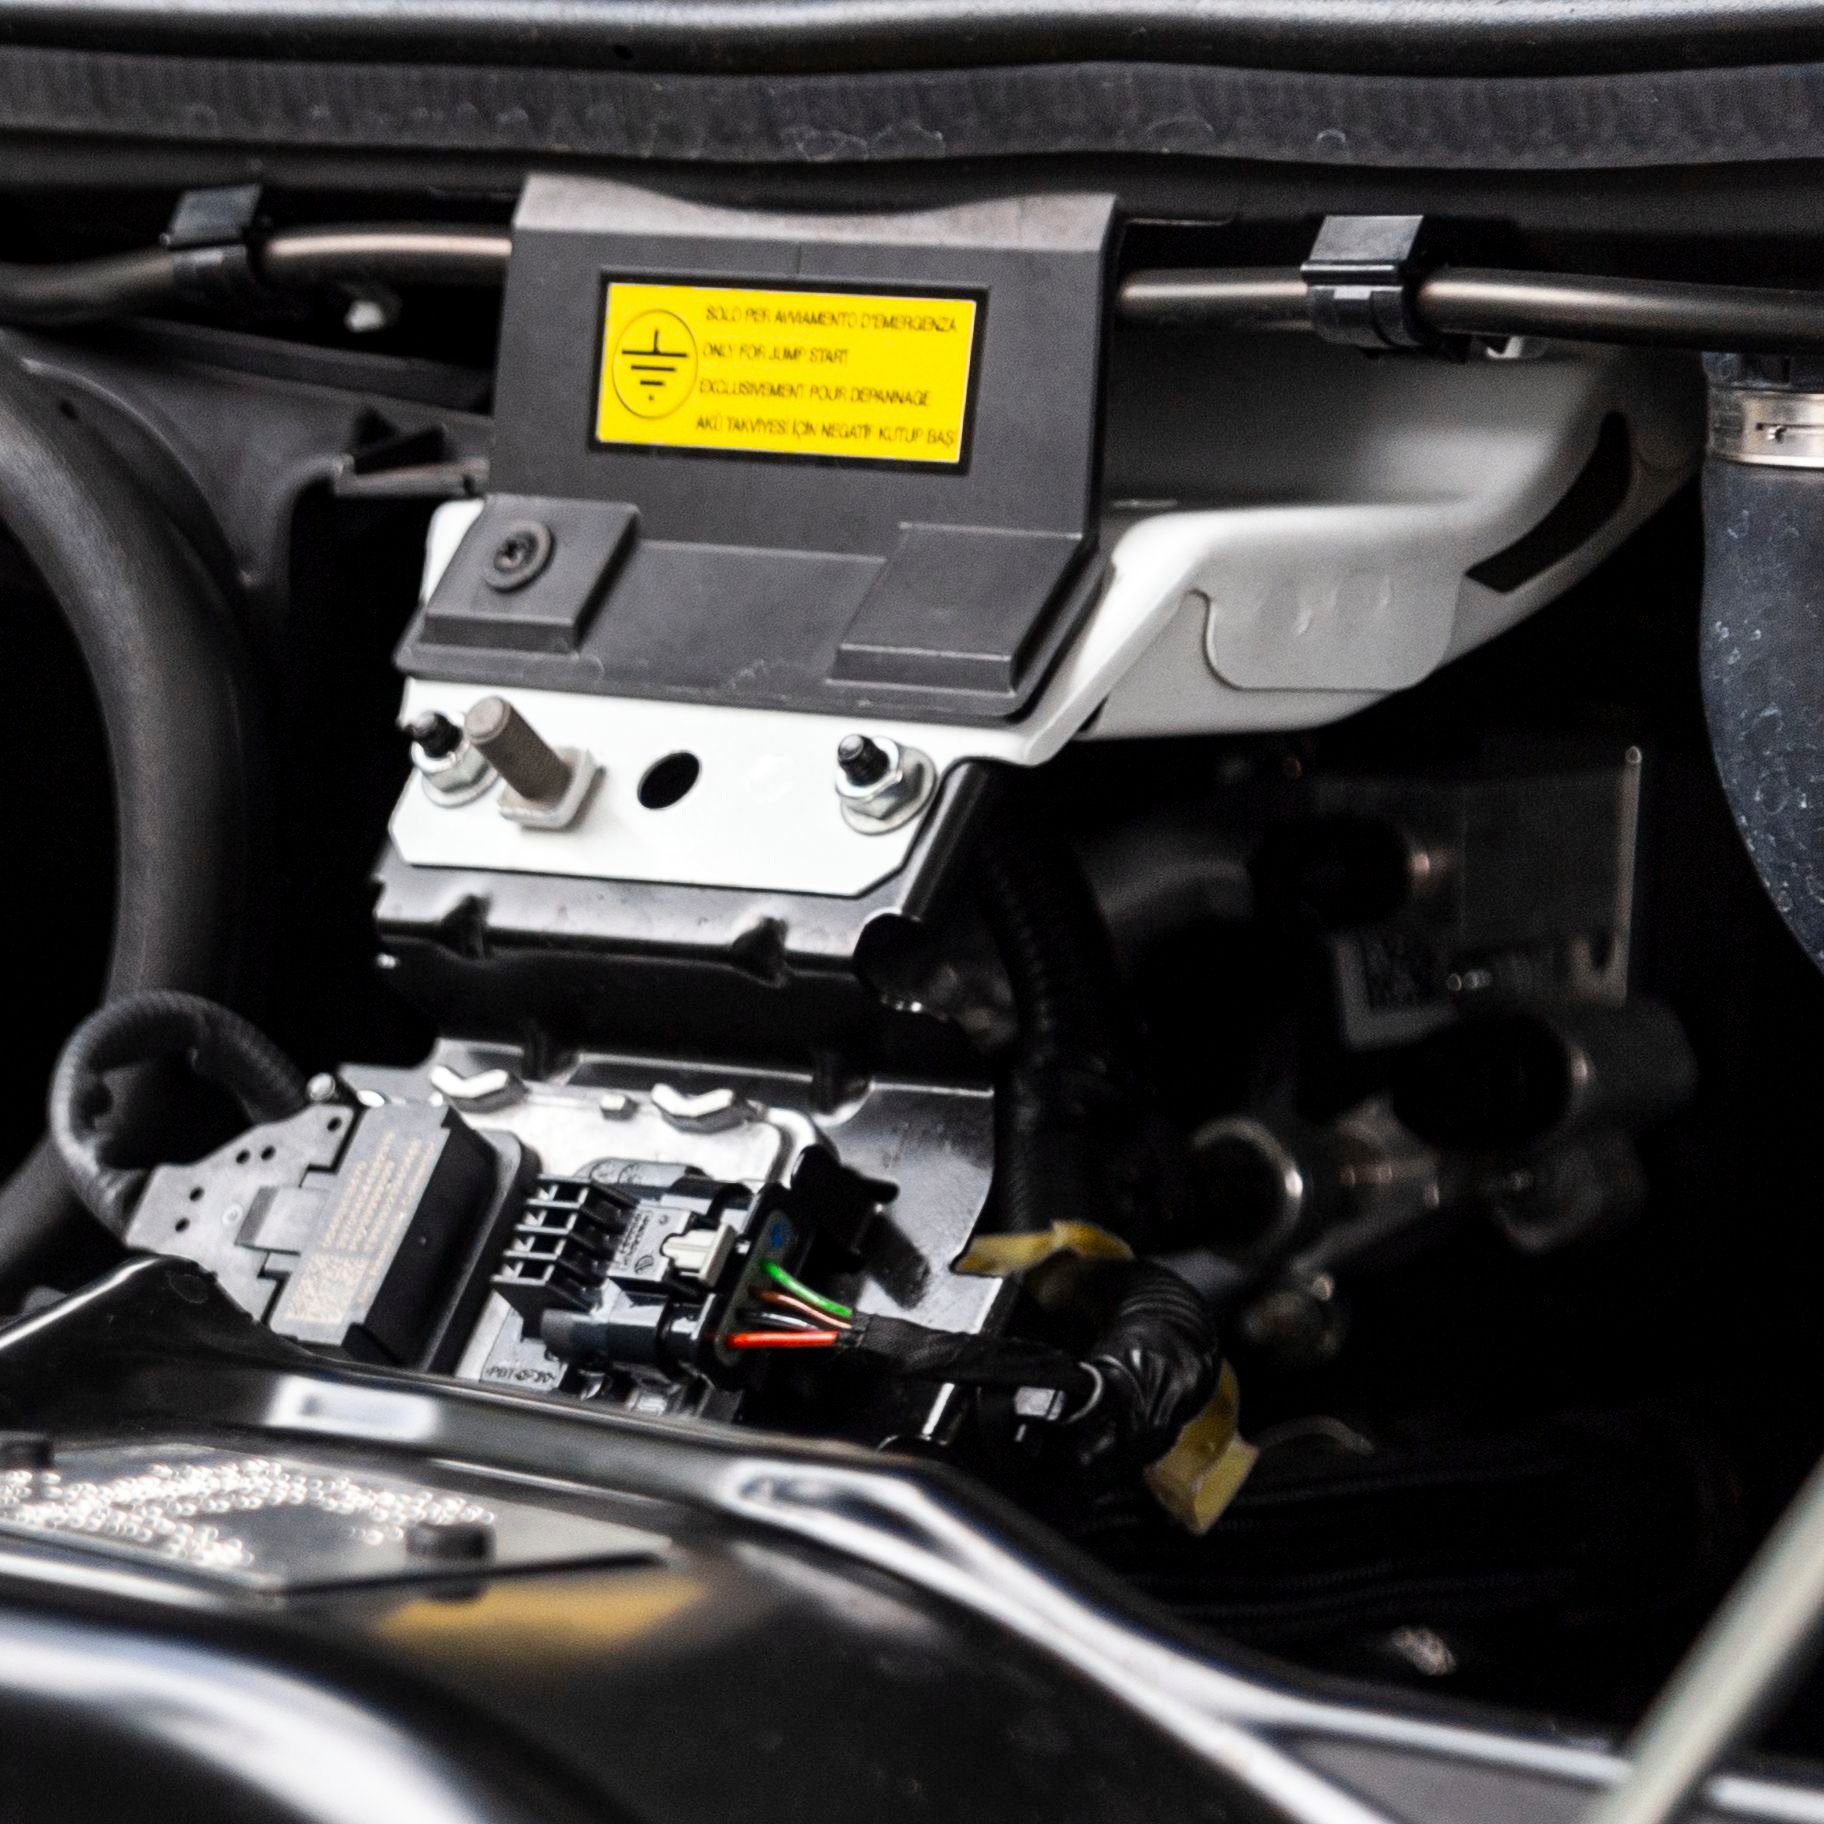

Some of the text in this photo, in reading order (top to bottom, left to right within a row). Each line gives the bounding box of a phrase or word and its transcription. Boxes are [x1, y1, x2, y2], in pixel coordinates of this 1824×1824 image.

[739, 343, 765, 360] FOR
[768, 344, 806, 362] JUMP
[808, 346, 849, 365] START
